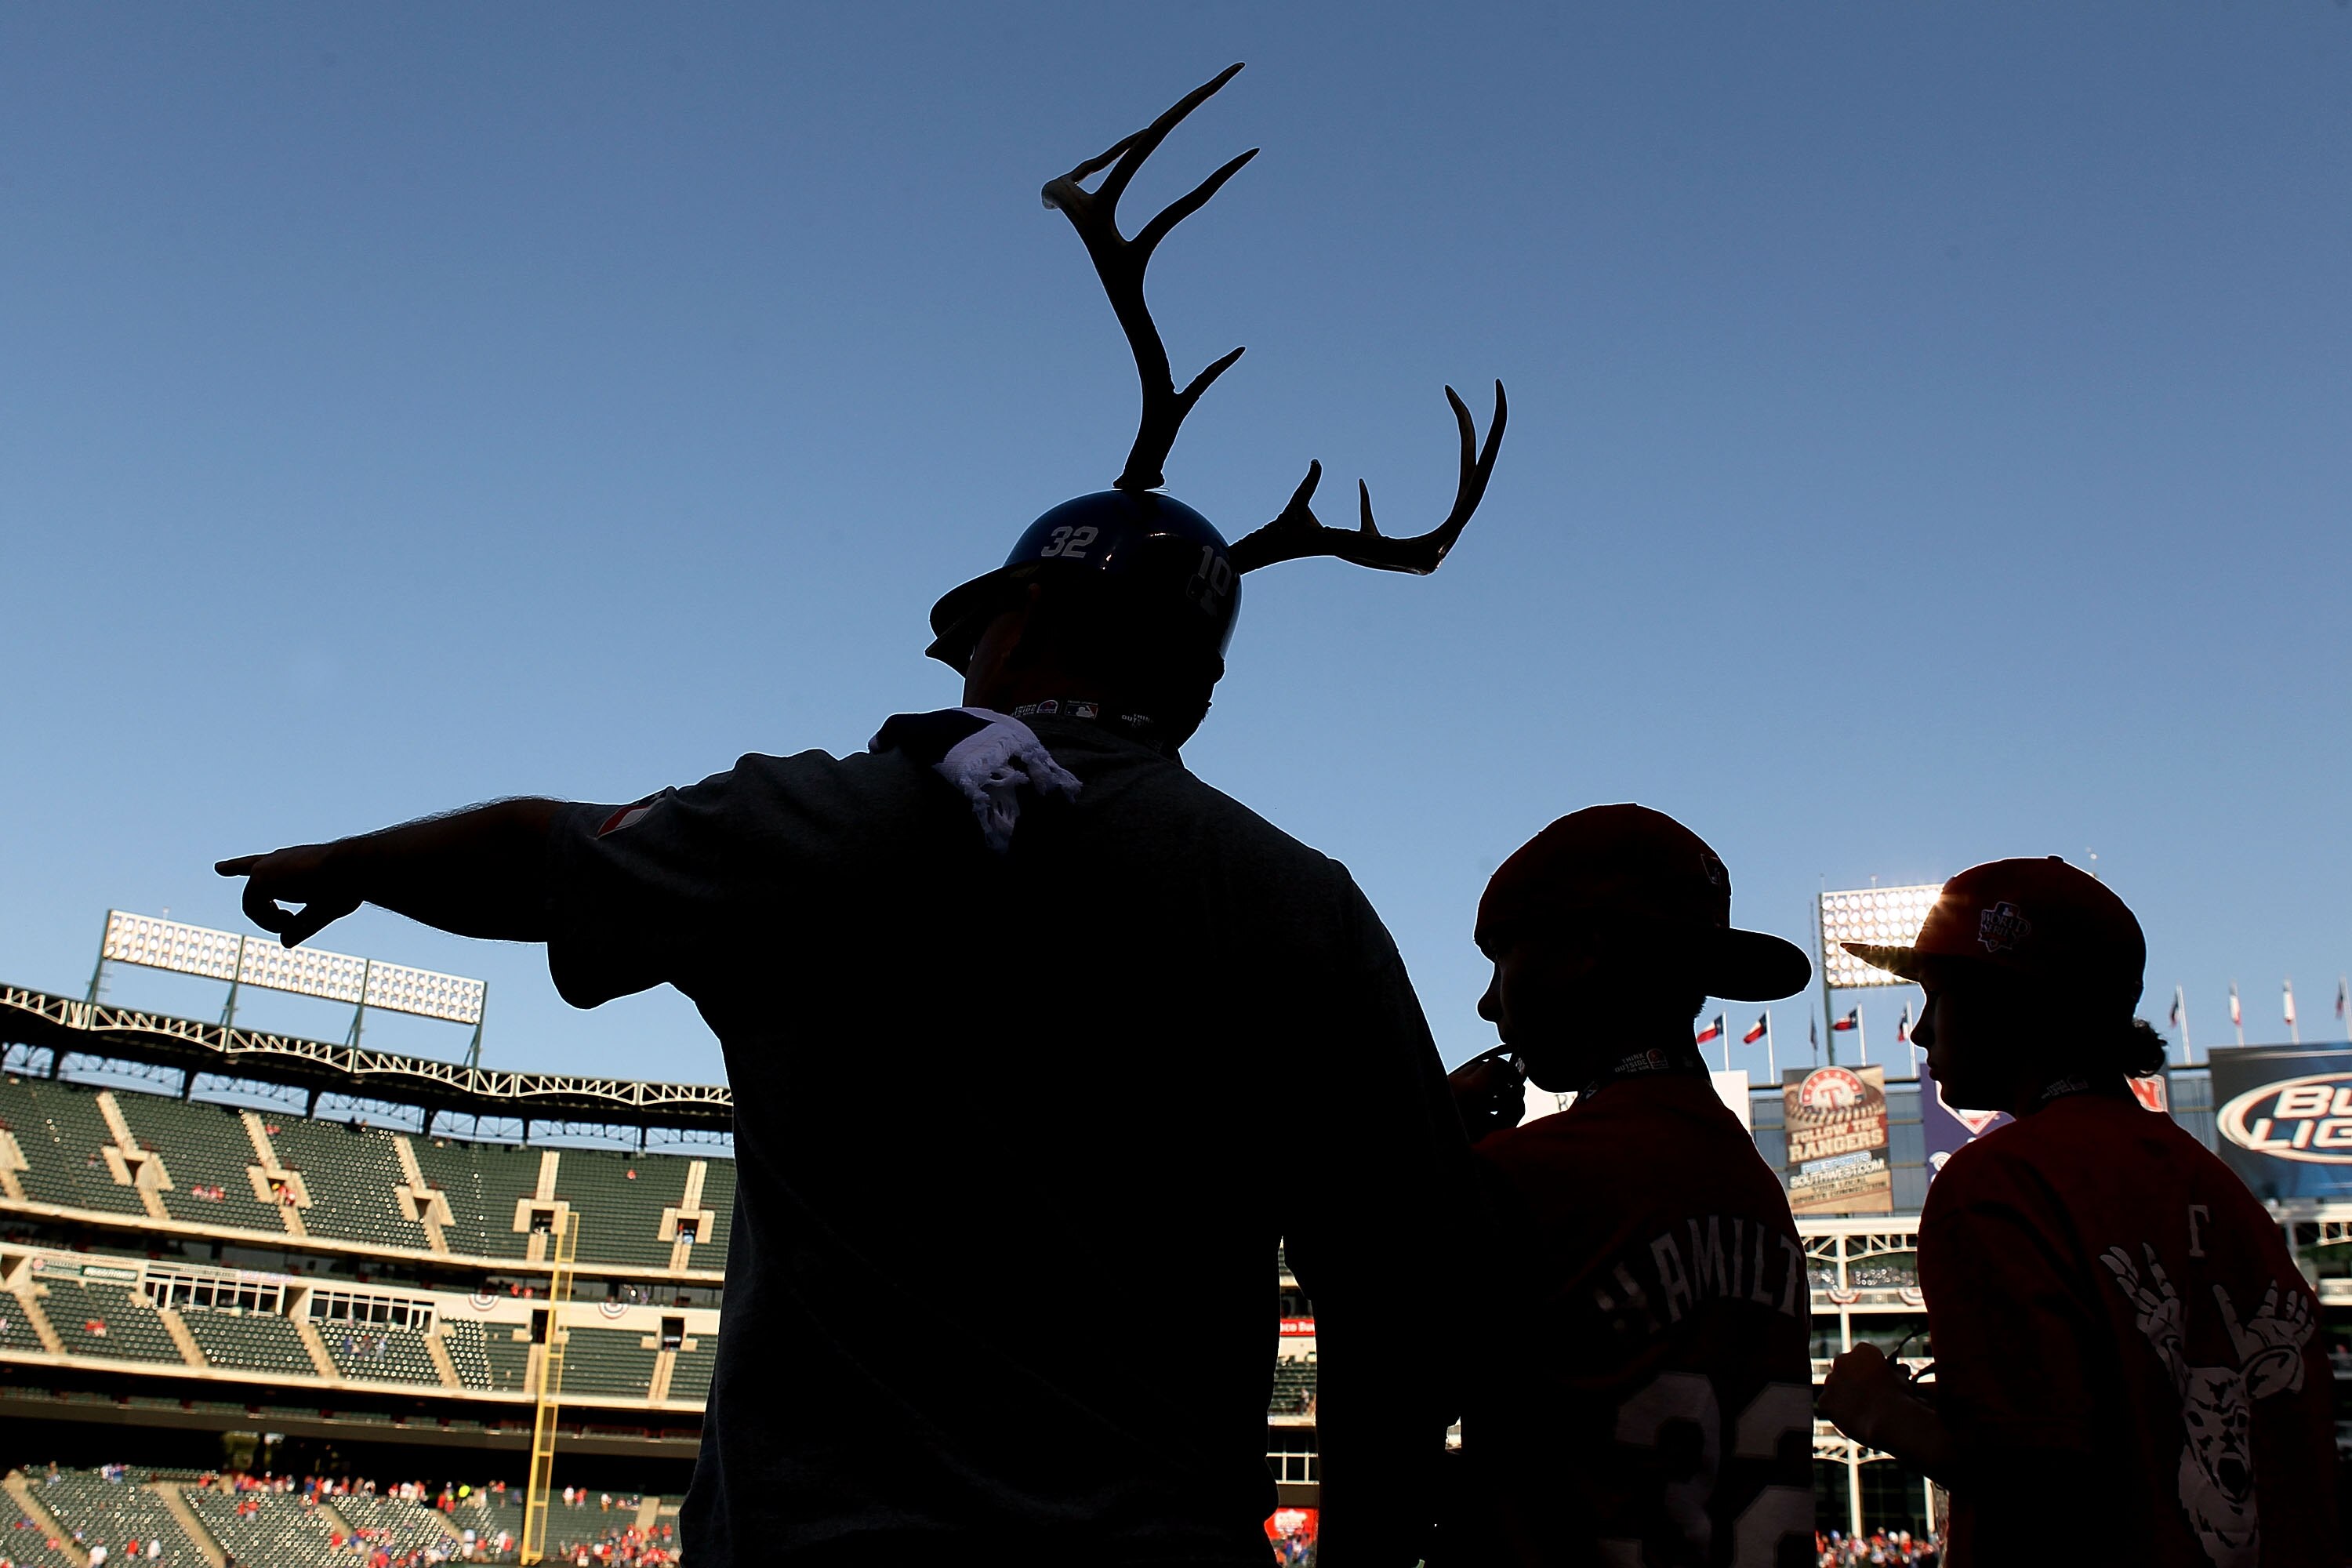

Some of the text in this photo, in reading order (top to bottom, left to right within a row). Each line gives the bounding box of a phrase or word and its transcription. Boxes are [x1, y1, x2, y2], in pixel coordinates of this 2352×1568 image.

[1040, 526, 1099, 559] 32
[1197, 545, 1232, 597] 10
[1788, 1129, 1885, 1163] RANGERS
[1791, 1116, 1879, 1145] FOLLOW THE
[1593, 1214, 1811, 1334] HAMILT
